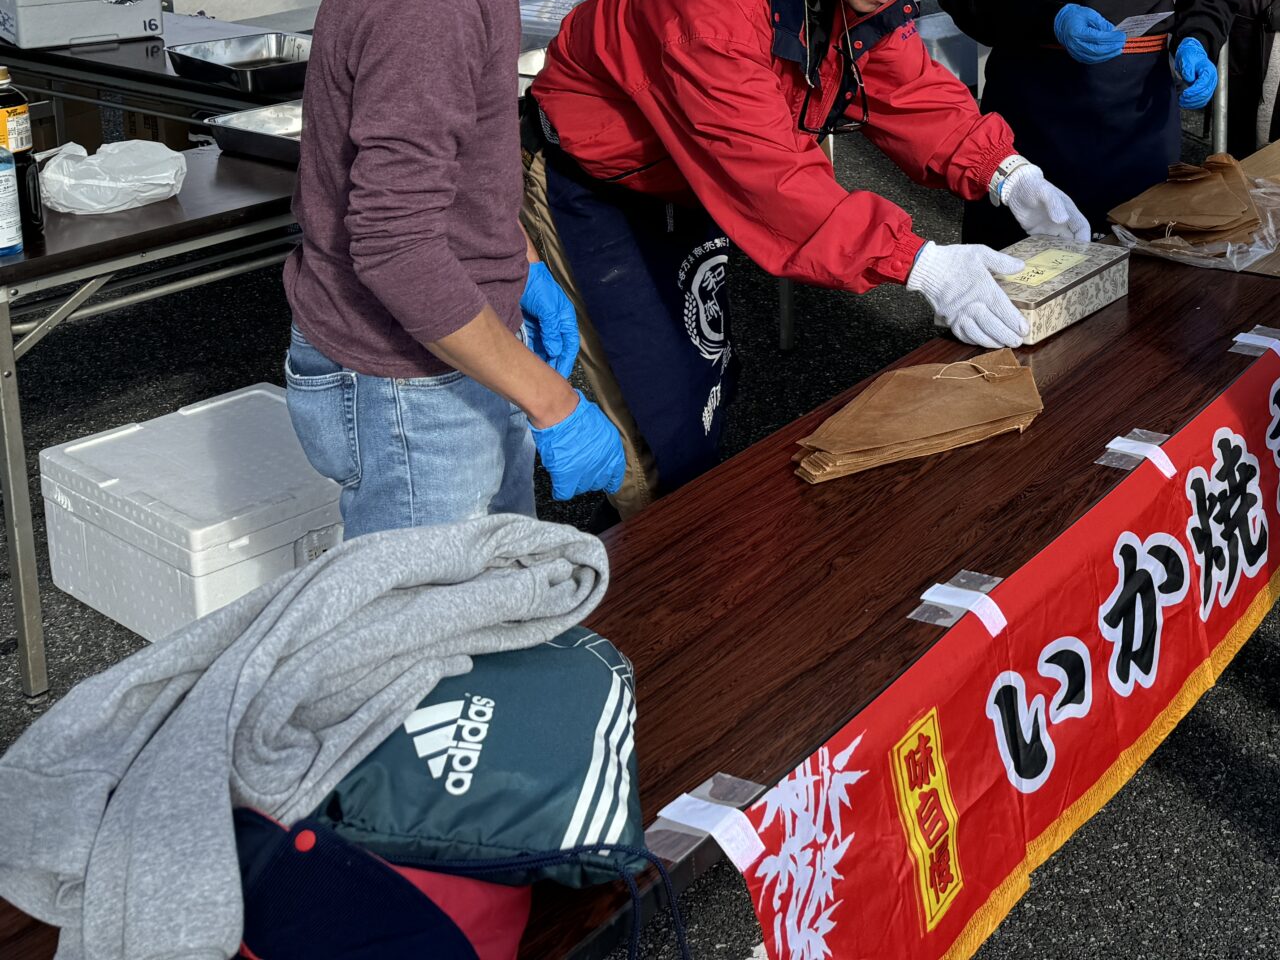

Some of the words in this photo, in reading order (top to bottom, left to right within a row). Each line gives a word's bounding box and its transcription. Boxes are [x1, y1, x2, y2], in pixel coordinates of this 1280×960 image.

[143, 19, 159, 32] 16
[445, 692, 496, 796] adidas
[904, 731, 957, 905] 味自慢
